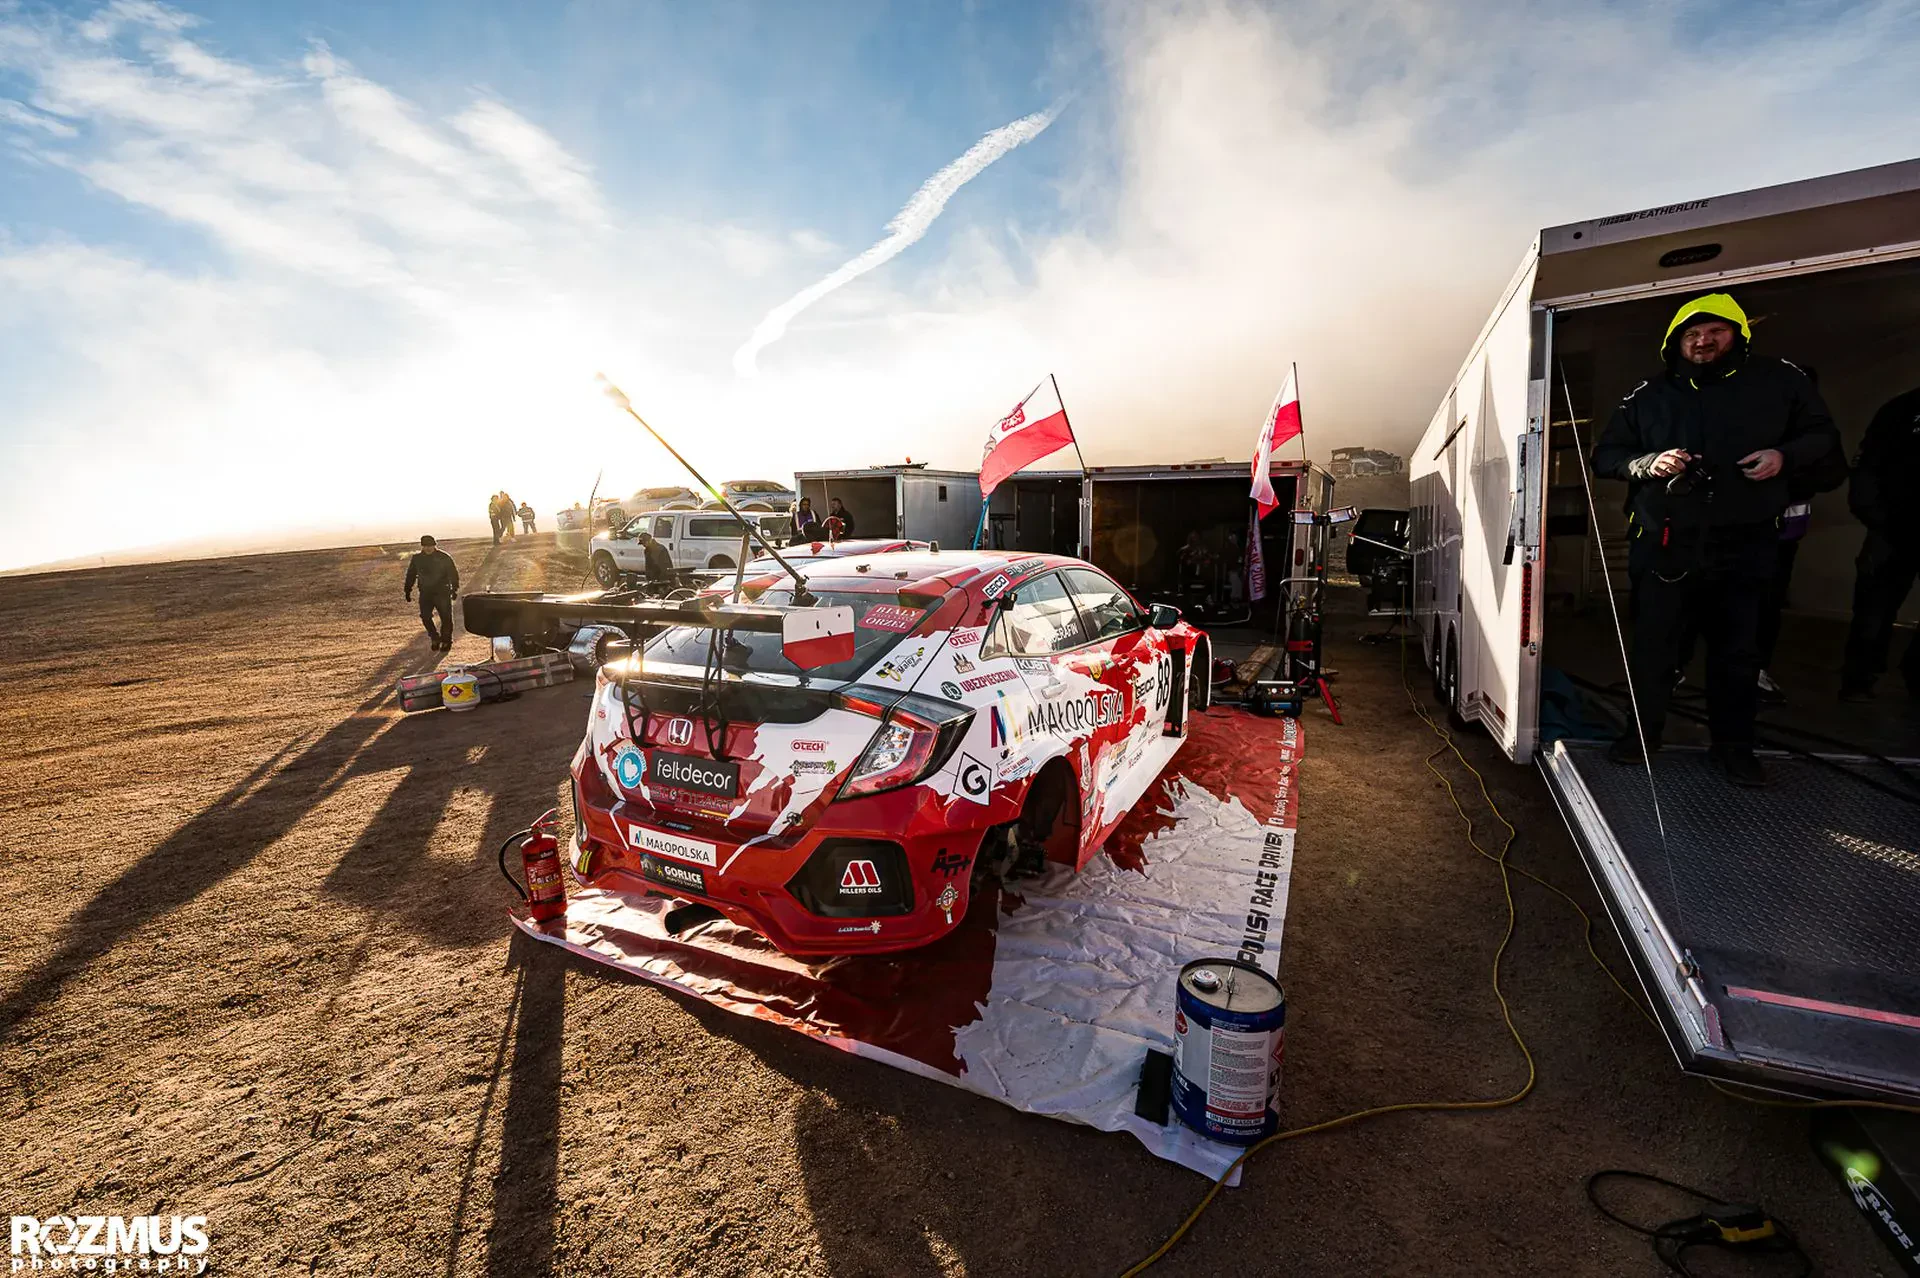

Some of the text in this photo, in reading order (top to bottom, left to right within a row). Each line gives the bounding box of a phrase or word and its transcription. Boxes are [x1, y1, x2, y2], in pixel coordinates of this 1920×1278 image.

[1632, 199, 1709, 221] FEATHERLITE
[985, 576, 1007, 597] GEICO
[949, 631, 979, 647] OTECH
[961, 670, 1019, 692] UBEZPIECZENIA
[1156, 656, 1173, 711] 88
[1028, 692, 1124, 735] MAŁOPOLSKA
[793, 741, 824, 751] OTECH
[657, 758, 731, 790] feltdecor
[962, 764, 988, 795] G
[646, 837, 711, 862] MAŁOPOLSKA
[1258, 832, 1283, 869] DRIVER
[664, 865, 703, 885] GORLICE
[839, 887, 867, 895] MILLERS
[1250, 870, 1279, 908] RACE
[1866, 1193, 1913, 1249] RACE
